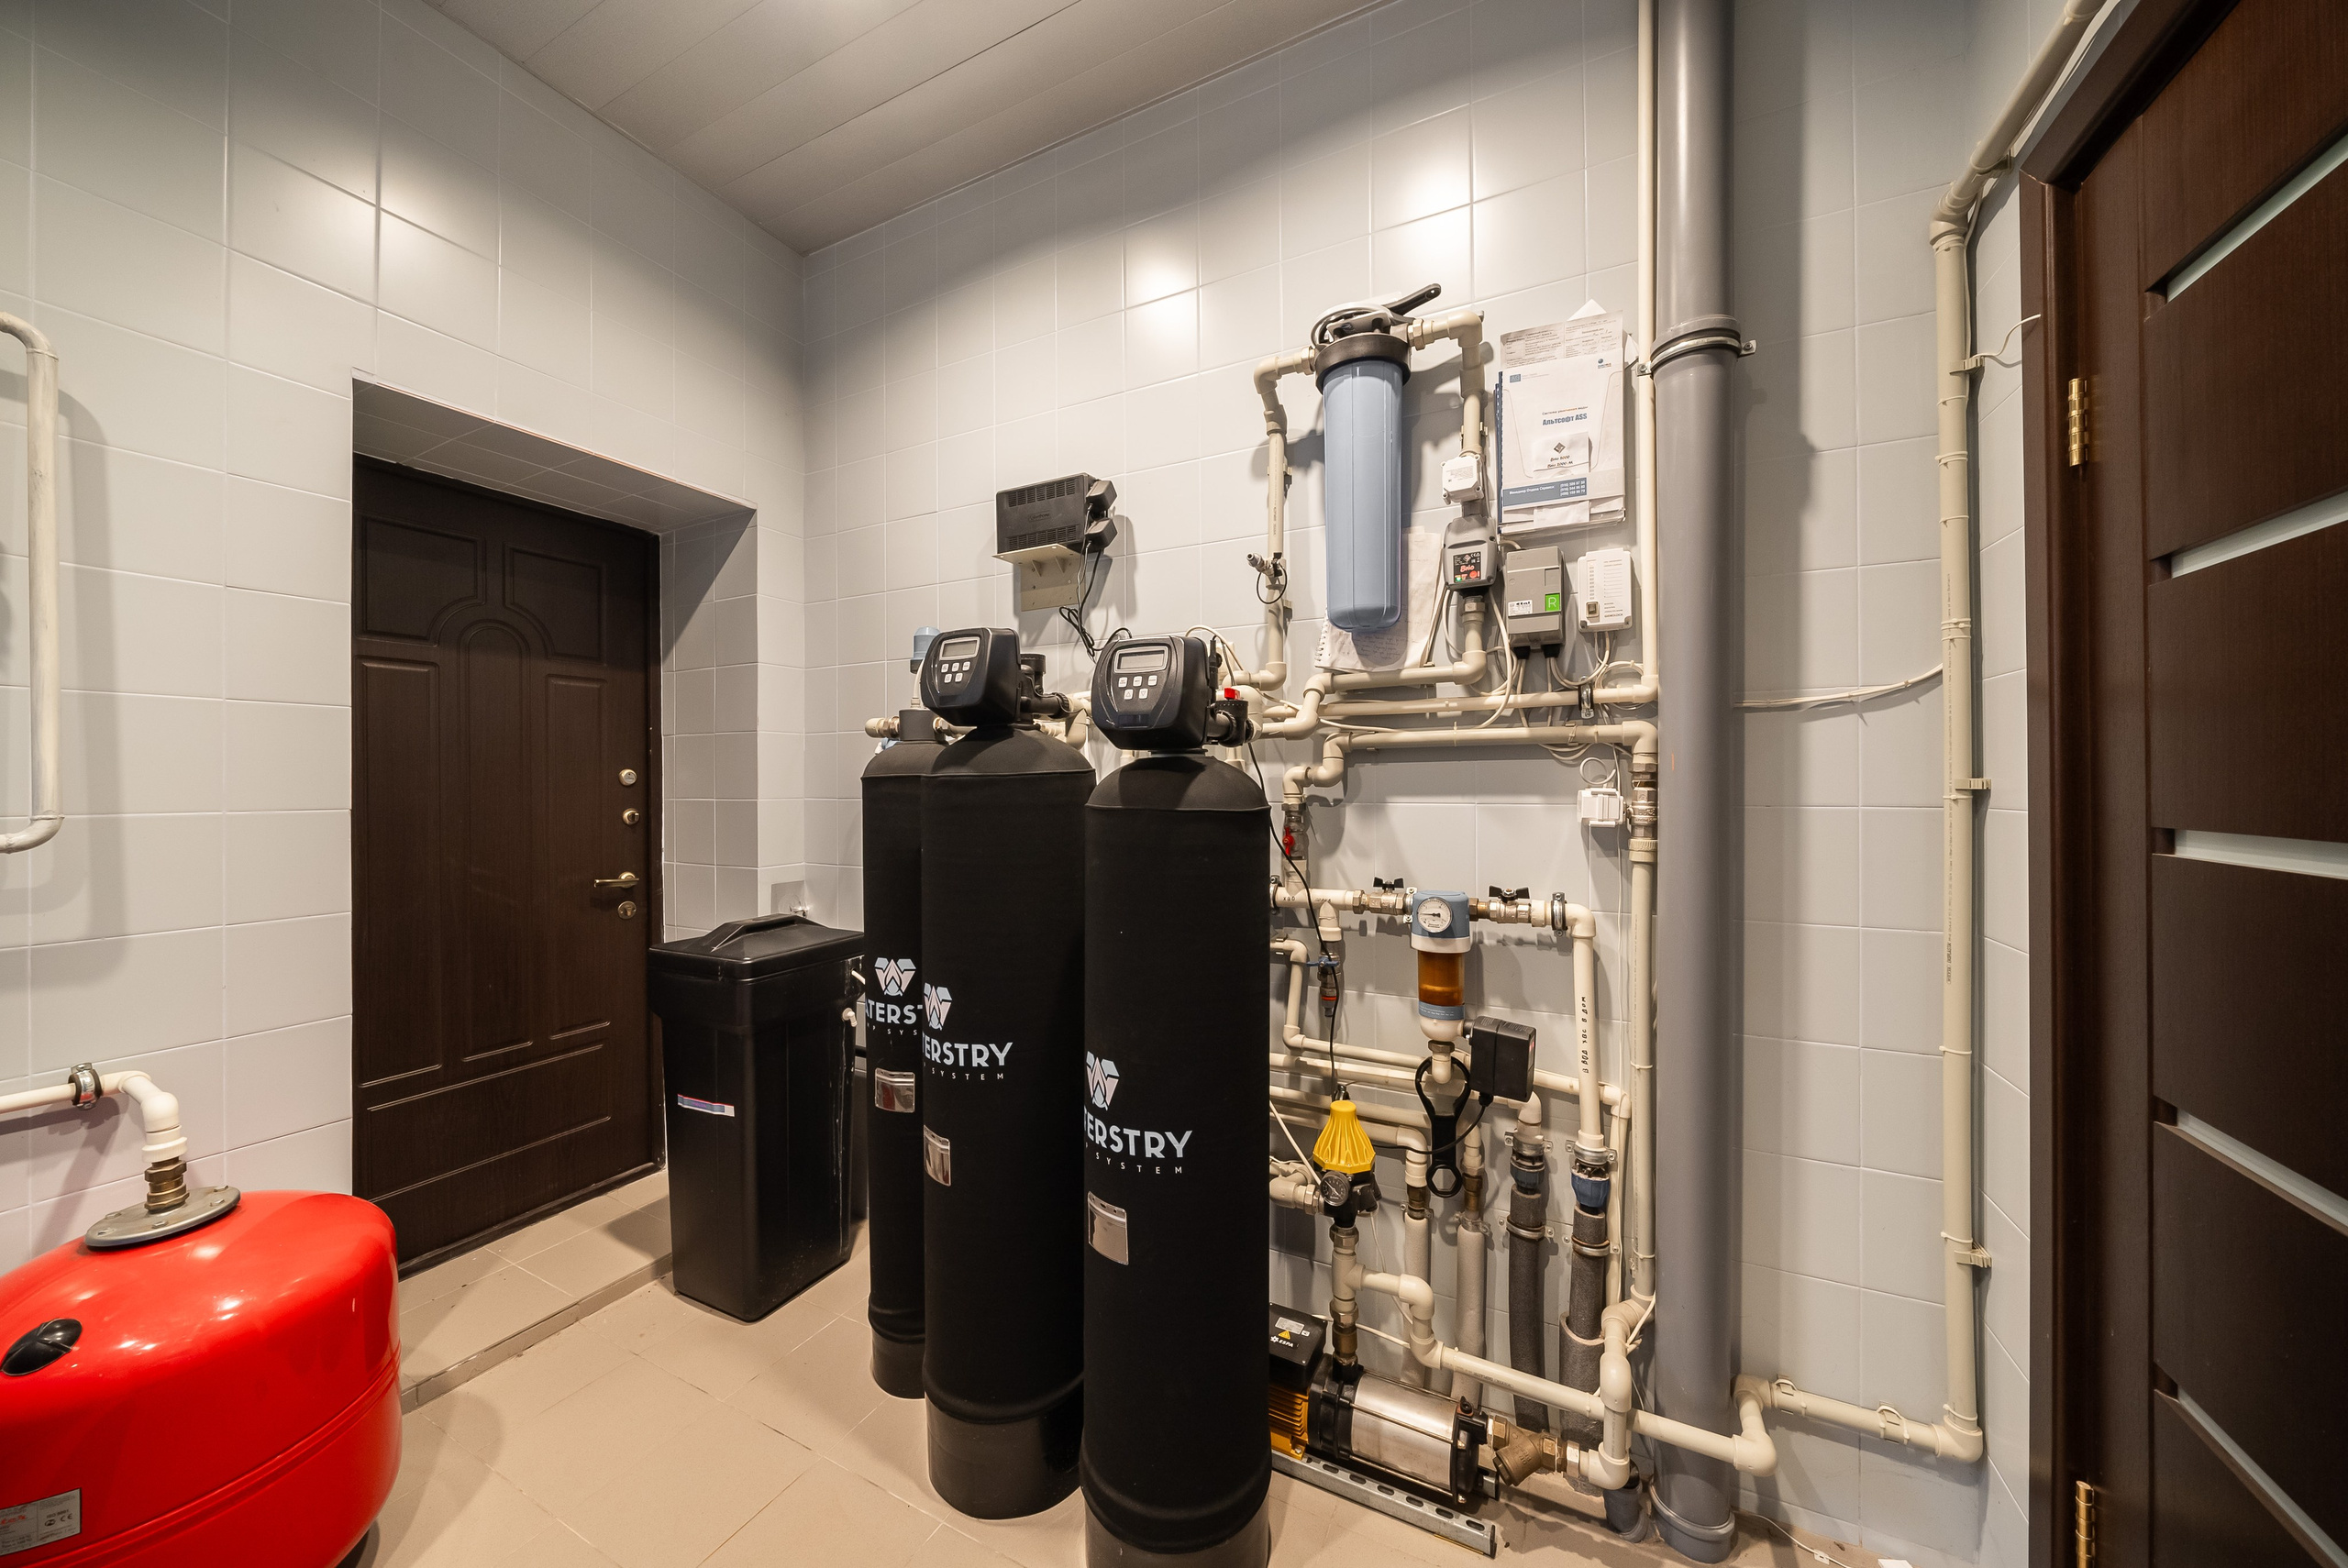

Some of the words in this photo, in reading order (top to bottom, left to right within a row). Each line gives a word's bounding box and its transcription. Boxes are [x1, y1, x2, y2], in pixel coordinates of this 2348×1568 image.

[1542, 415, 1575, 425] Альтсофт
[1575, 413, 1588, 421] ASS
[1548, 597, 1557, 608] R
[932, 1067, 1004, 1080] SYSTEM
[1095, 1152, 1182, 1175] SYSTEM
